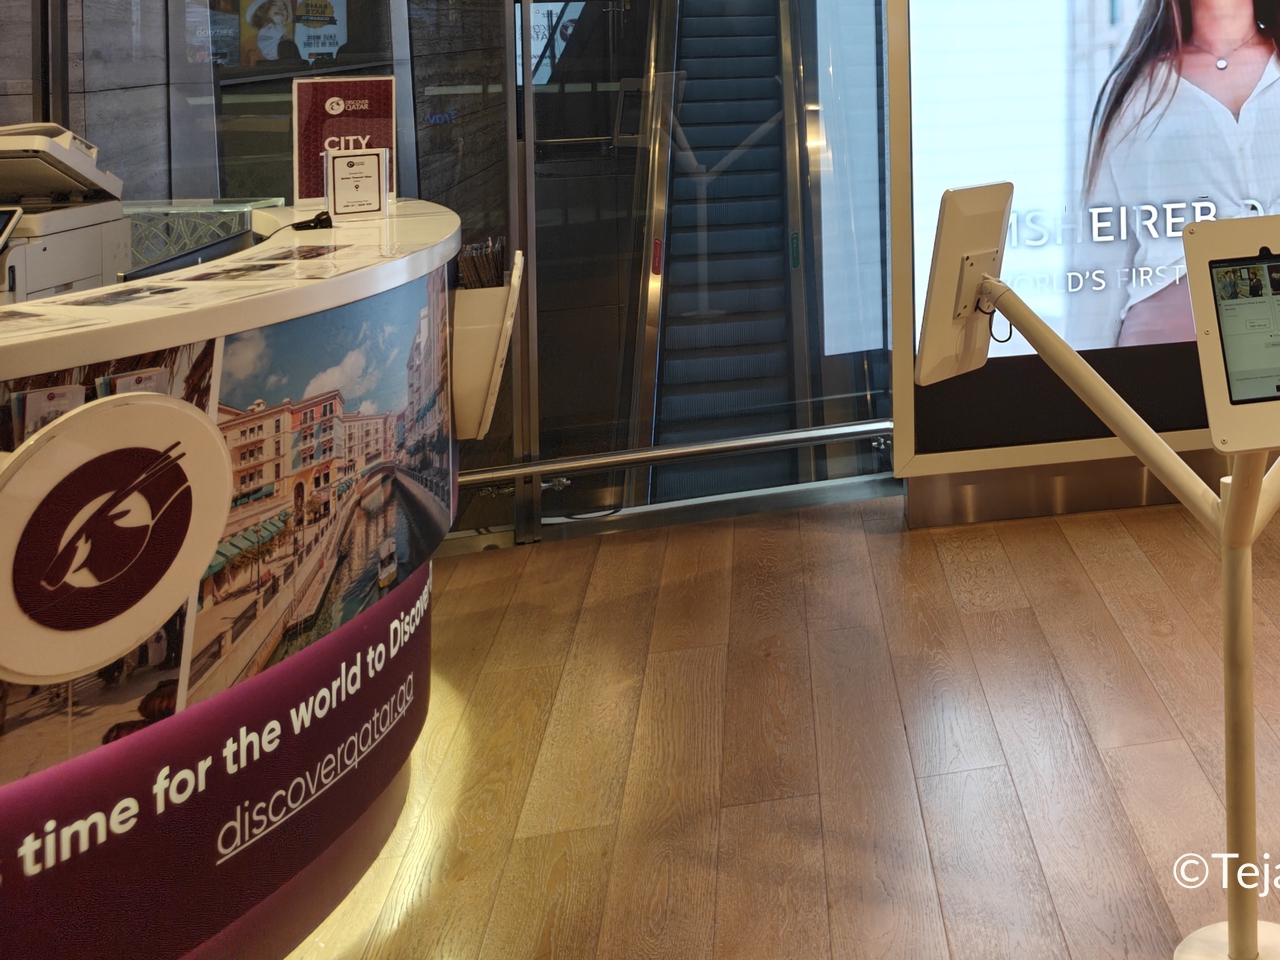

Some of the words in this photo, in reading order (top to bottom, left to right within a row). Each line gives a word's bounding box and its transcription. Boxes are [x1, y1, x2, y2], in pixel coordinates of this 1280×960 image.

[345, 103, 369, 111] QATAR
[324, 135, 371, 151] CITY
[1116, 265, 1186, 289] FIRST
[17, 797, 139, 878] time
[153, 754, 213, 814] for
[222, 717, 281, 775] the
[290, 652, 362, 735] world
[366, 646, 387, 678] to
[216, 671, 414, 862] discoverqatar.qa
